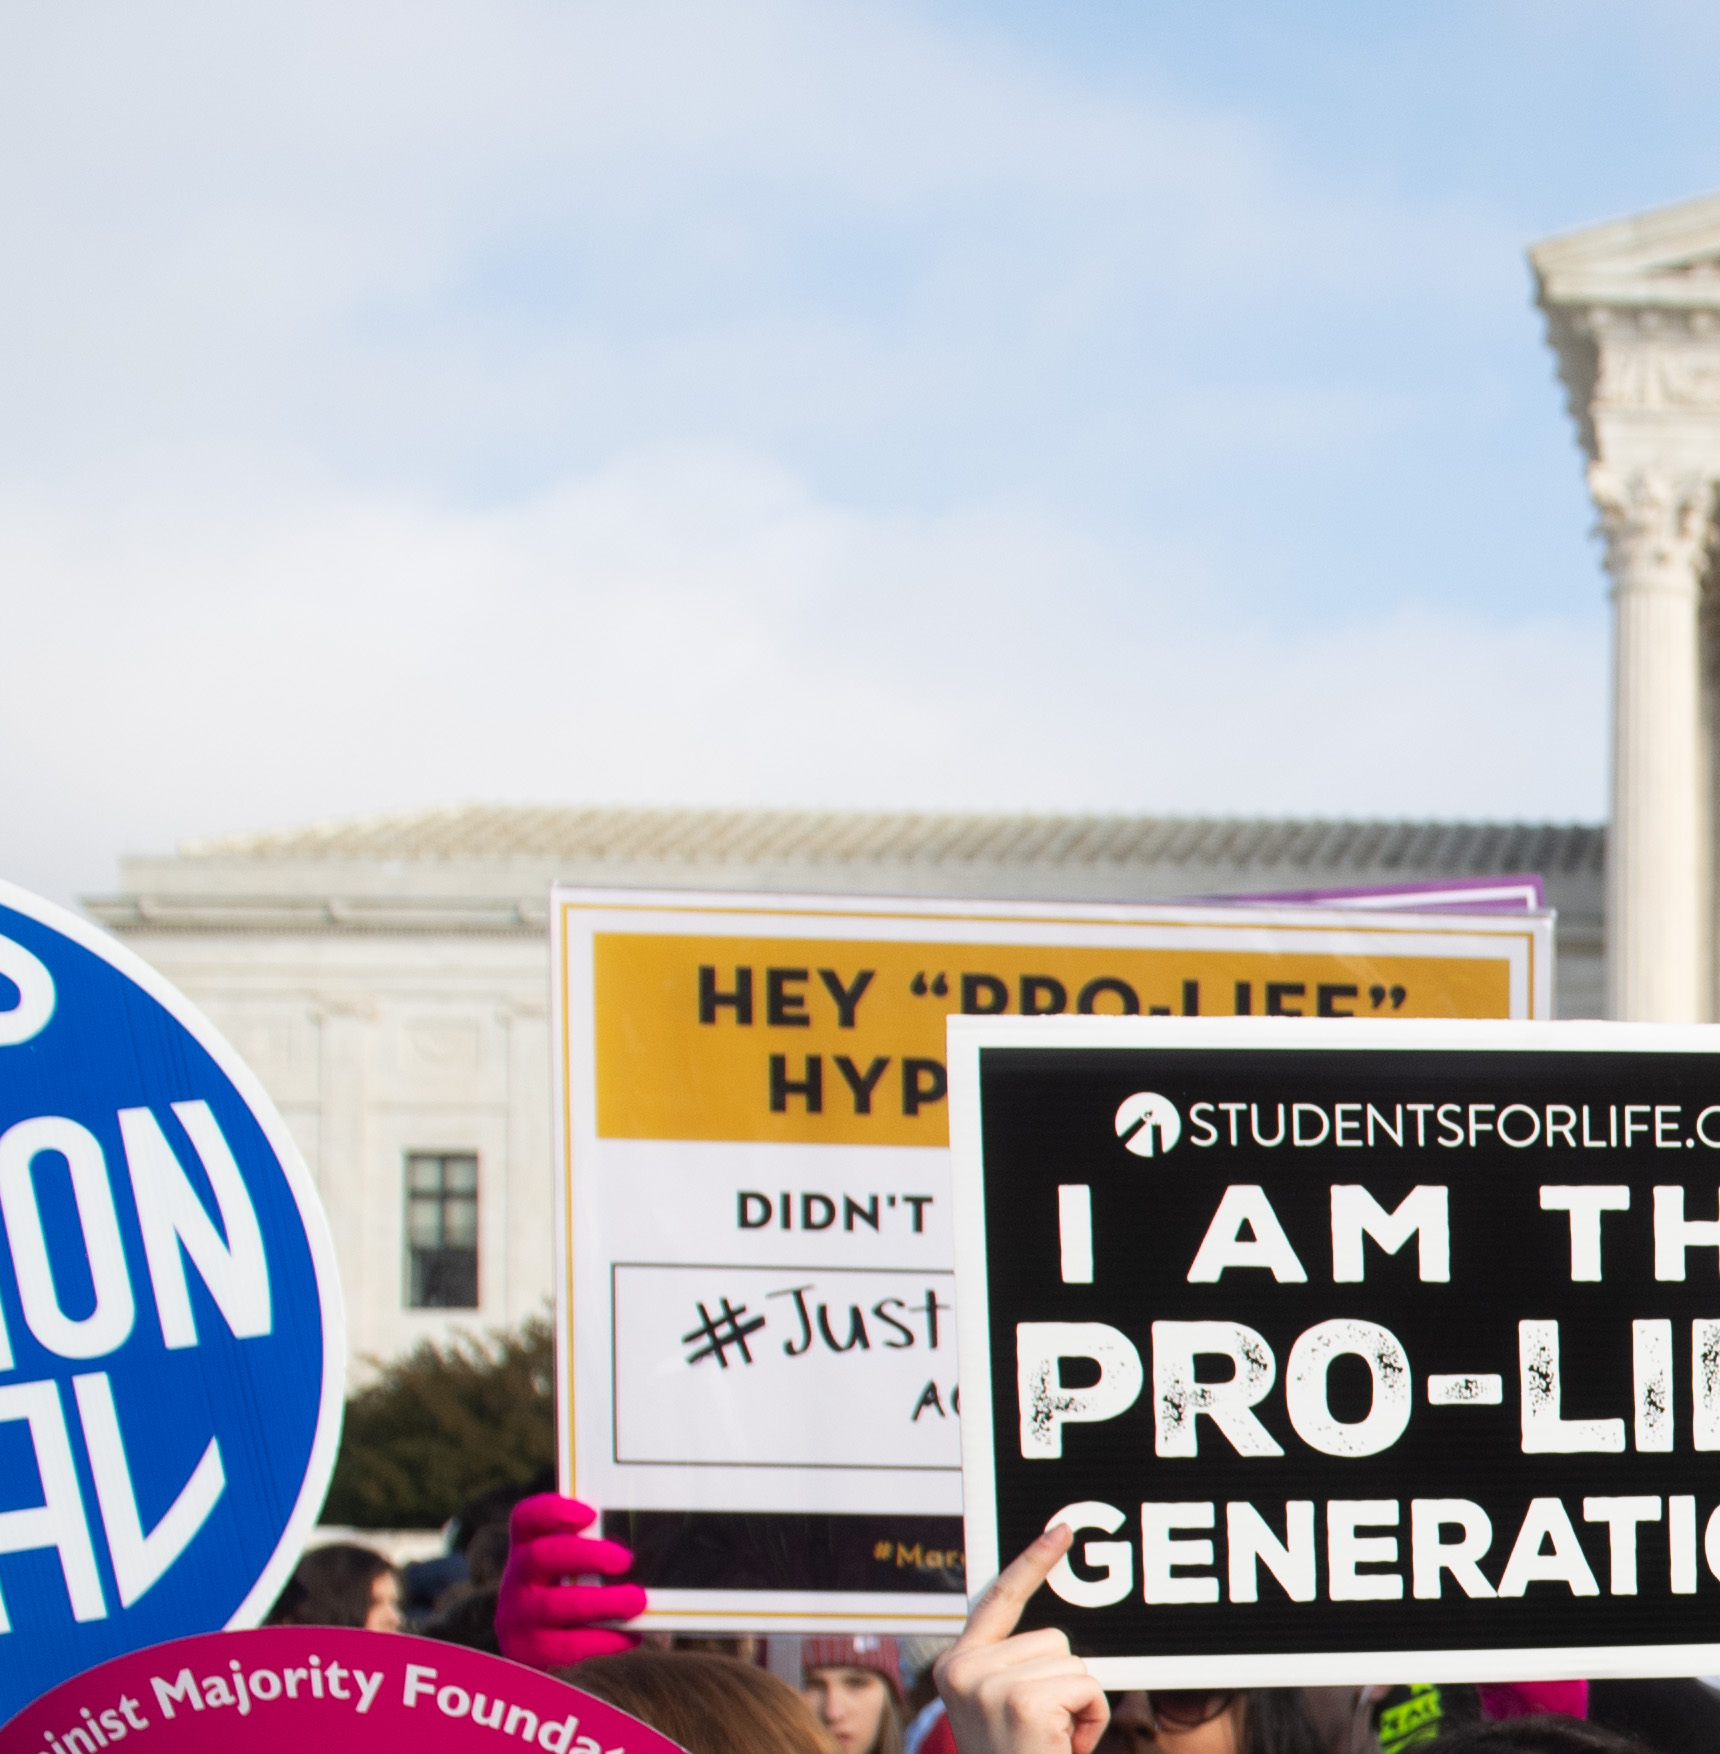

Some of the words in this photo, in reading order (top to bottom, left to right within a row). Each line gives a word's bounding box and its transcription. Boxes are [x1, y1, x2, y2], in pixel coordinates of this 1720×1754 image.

[697, 963, 876, 1031] HEY
[0, 1098, 272, 1372] ON
[736, 1191, 934, 1231] DIDN'T
[1057, 1183, 1095, 1285] I
[1186, 1184, 1451, 1284] AM
[681, 1284, 951, 1370] #Just
[150, 1653, 385, 1720] Majority
